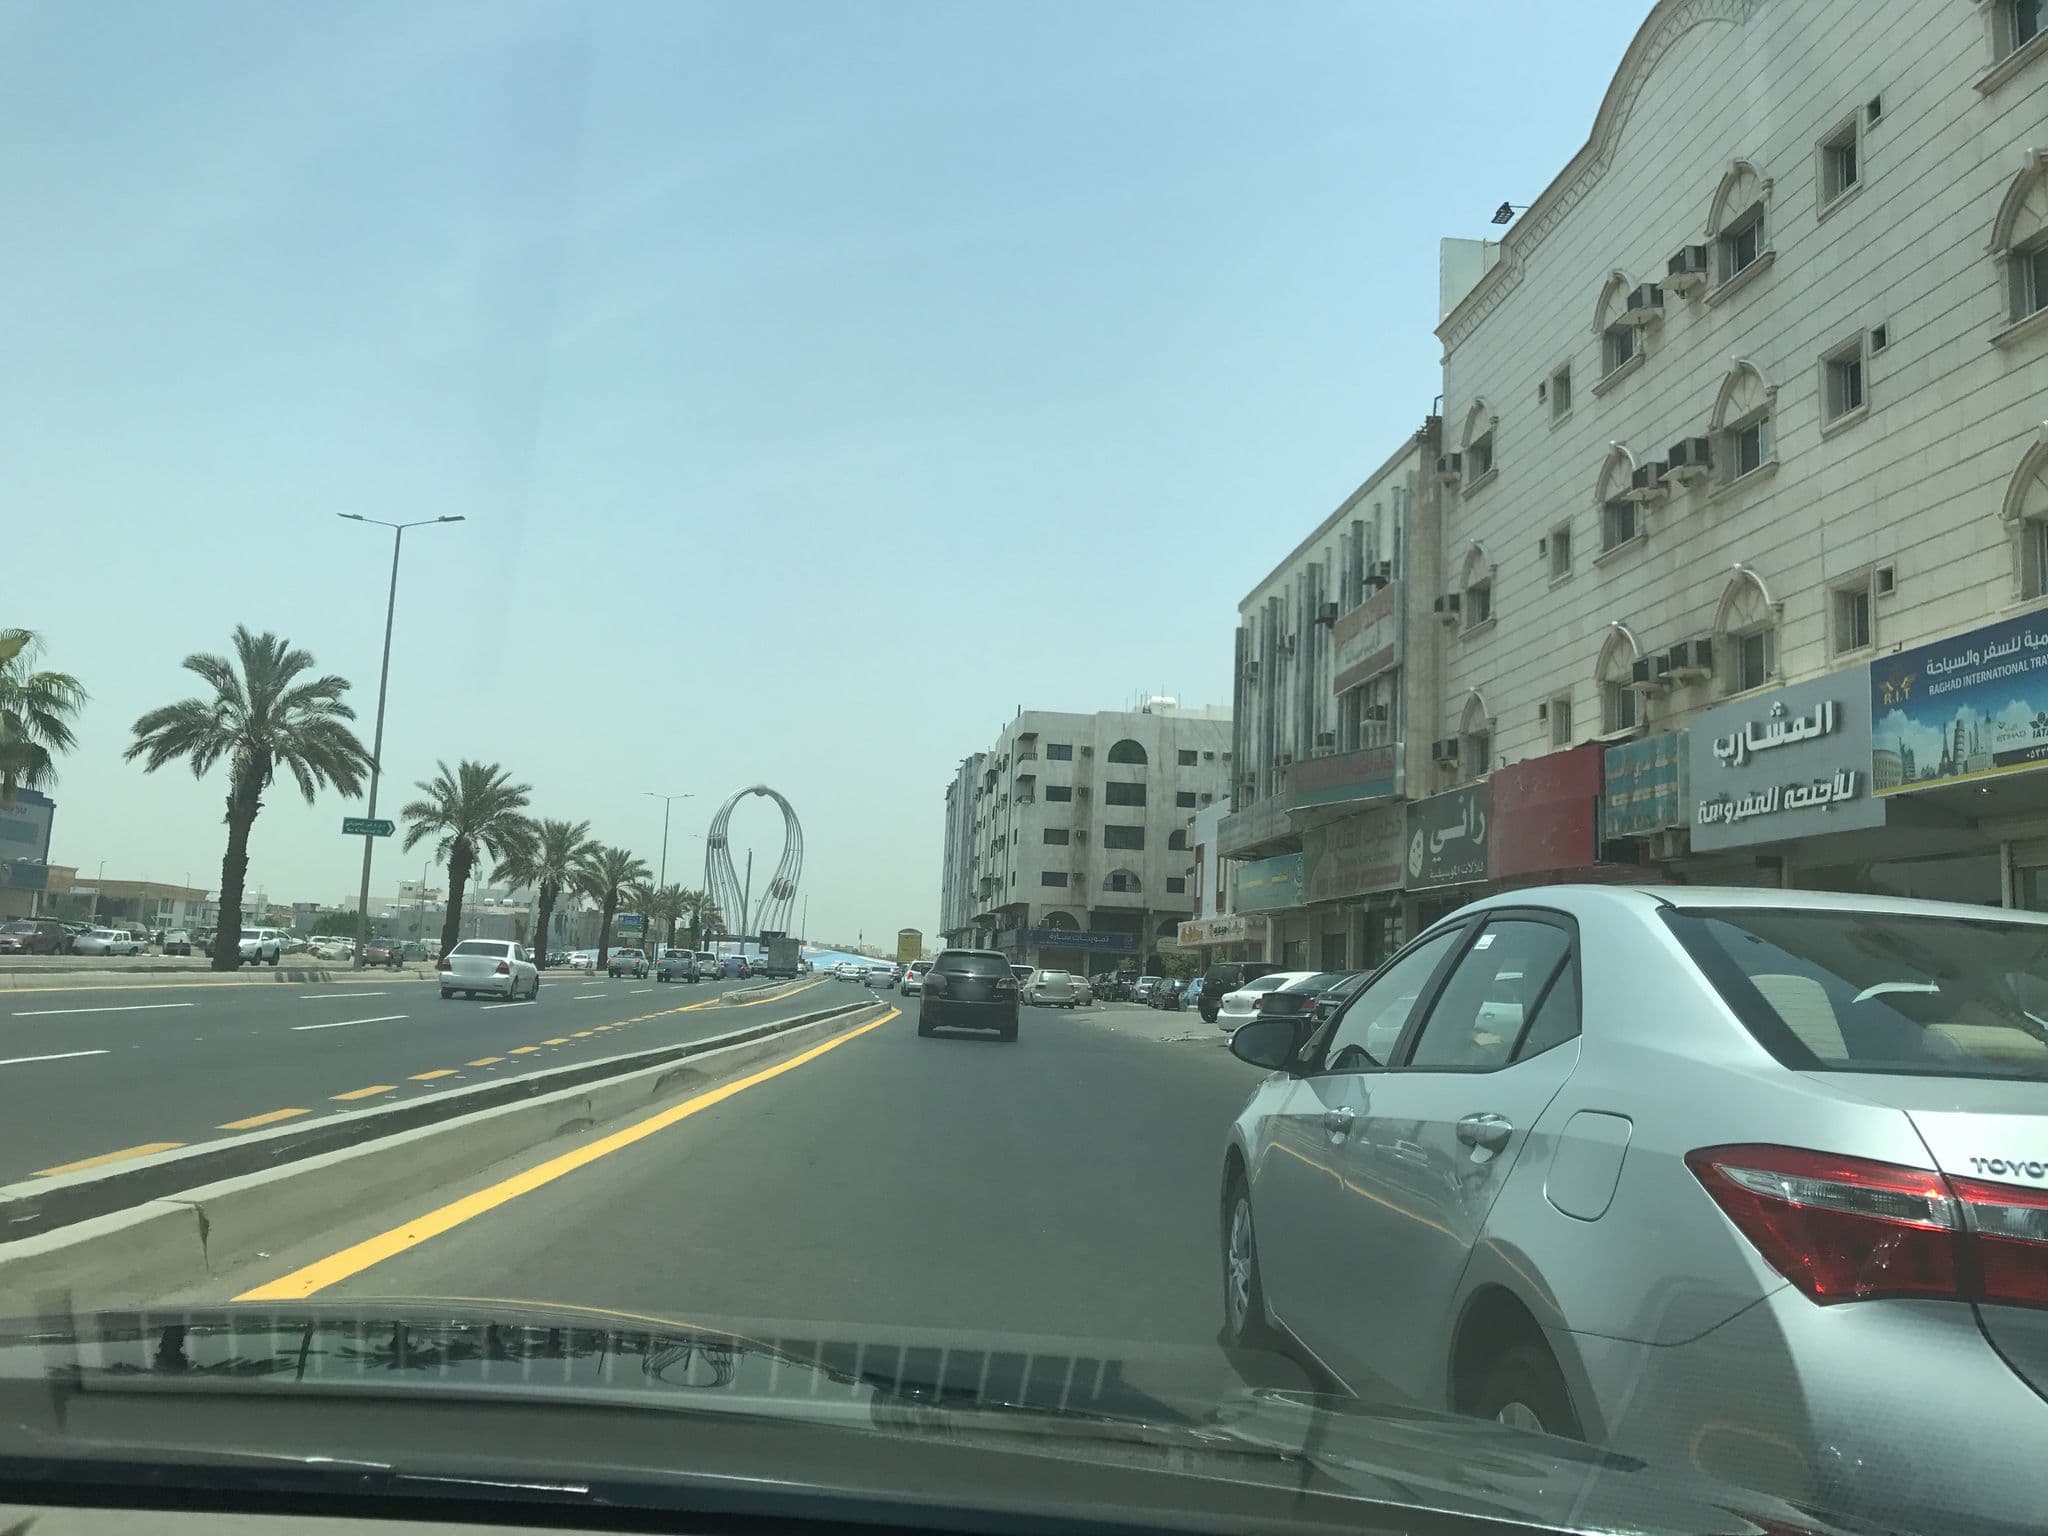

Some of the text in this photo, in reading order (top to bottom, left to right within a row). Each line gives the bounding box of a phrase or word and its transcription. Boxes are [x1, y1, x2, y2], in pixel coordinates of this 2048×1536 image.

[1926, 649, 1980, 676] والسياحة
[1983, 635, 2021, 664] للسفر
[1928, 678, 1962, 697] RAGHAD
[1963, 662, 2030, 688] INTERNATIONAL
[1712, 700, 1833, 768] المشارب
[1430, 794, 1486, 863] راني
[1969, 1157, 2048, 1179] TOYO
